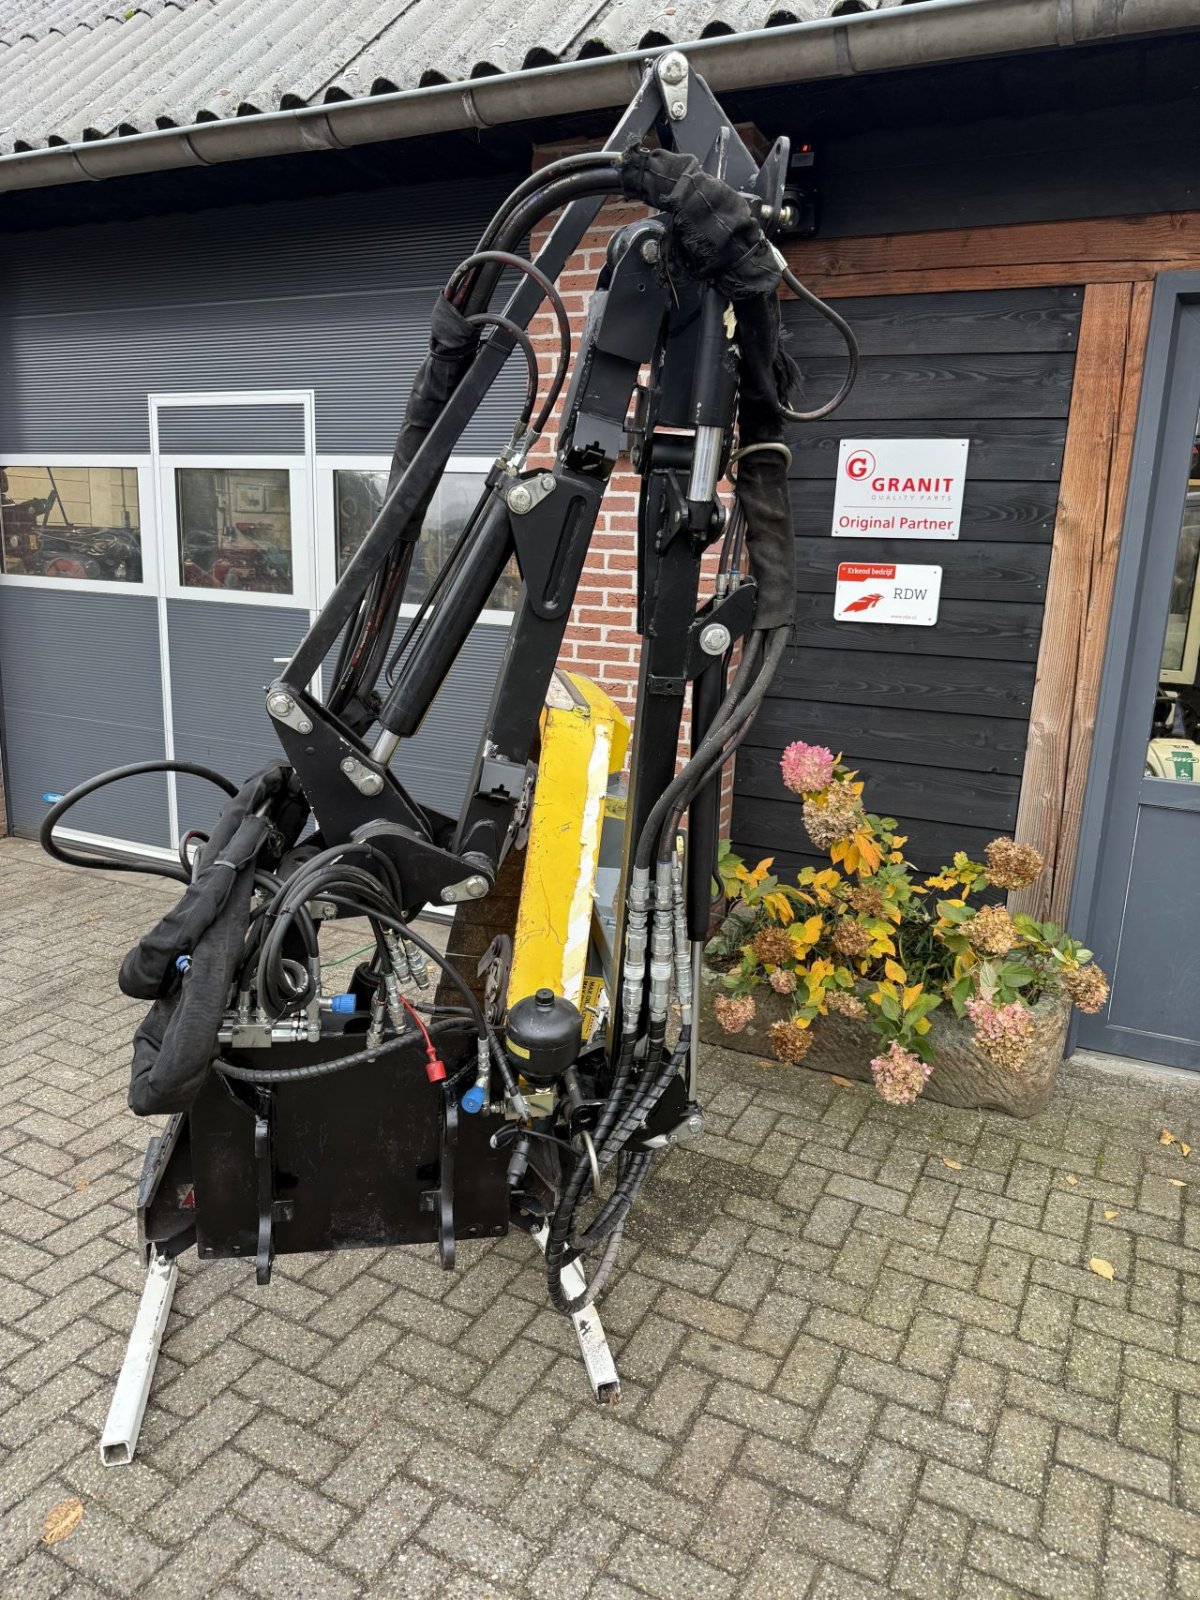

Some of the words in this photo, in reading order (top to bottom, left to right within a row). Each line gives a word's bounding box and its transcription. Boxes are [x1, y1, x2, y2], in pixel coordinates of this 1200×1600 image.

[849, 458, 867, 477] G
[871, 478, 953, 493] GRANIT
[839, 516, 895, 531] Original
[899, 517, 953, 530] Partner
[847, 567, 871, 575] Erkend
[871, 568, 893, 577] bedrijf
[893, 587, 928, 601] RDW
